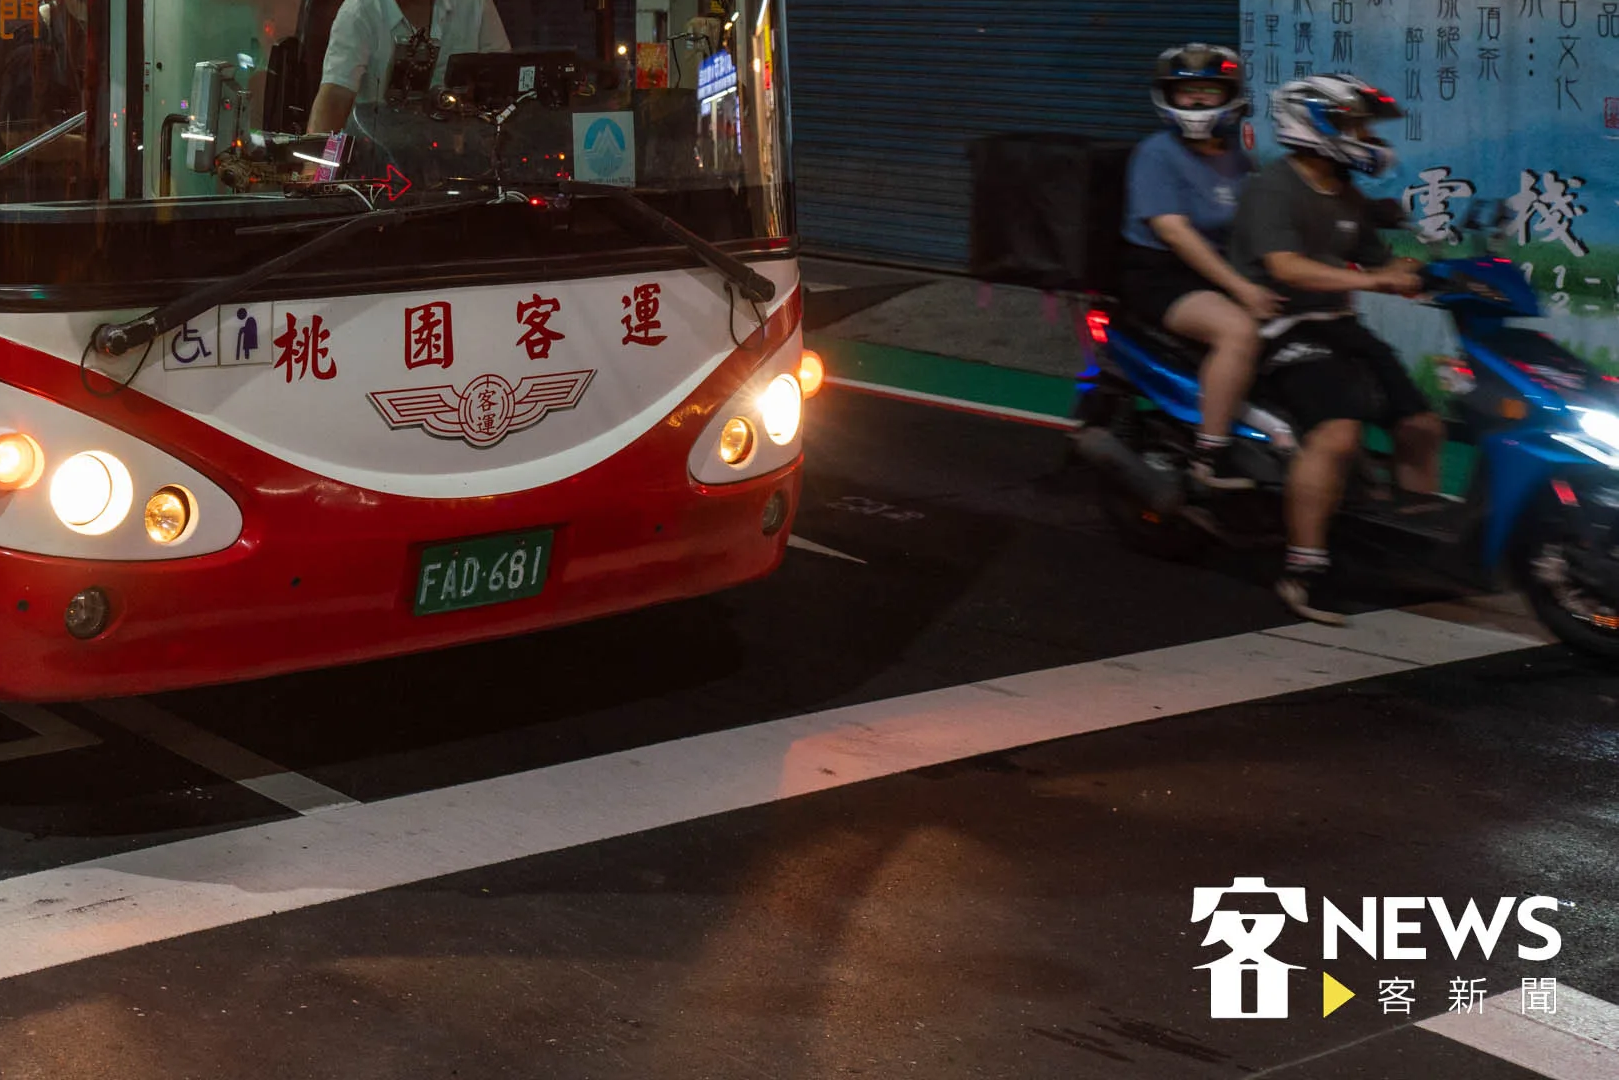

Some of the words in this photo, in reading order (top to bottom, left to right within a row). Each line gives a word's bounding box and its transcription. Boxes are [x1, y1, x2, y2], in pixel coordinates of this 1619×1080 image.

[273, 281, 668, 382] 桃園客運
[476, 388, 500, 437] 客運
